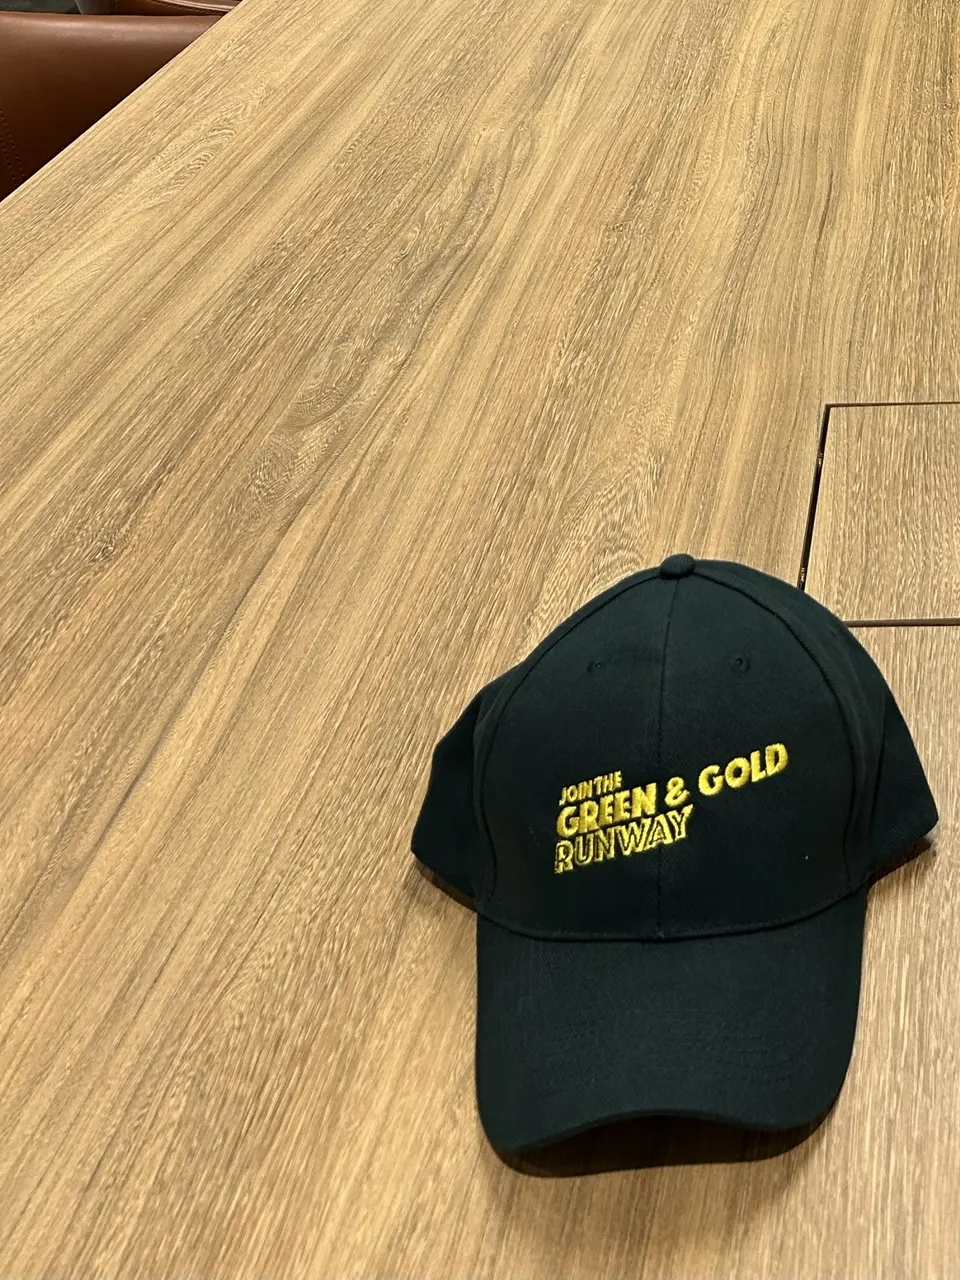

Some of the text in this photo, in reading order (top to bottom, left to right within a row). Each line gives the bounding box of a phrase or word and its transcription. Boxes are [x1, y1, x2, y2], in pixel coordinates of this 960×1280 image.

[556, 742, 789, 839] GREEN & GOLD
[559, 770, 622, 806] JOIN THE
[554, 803, 694, 874] RUNWAY
